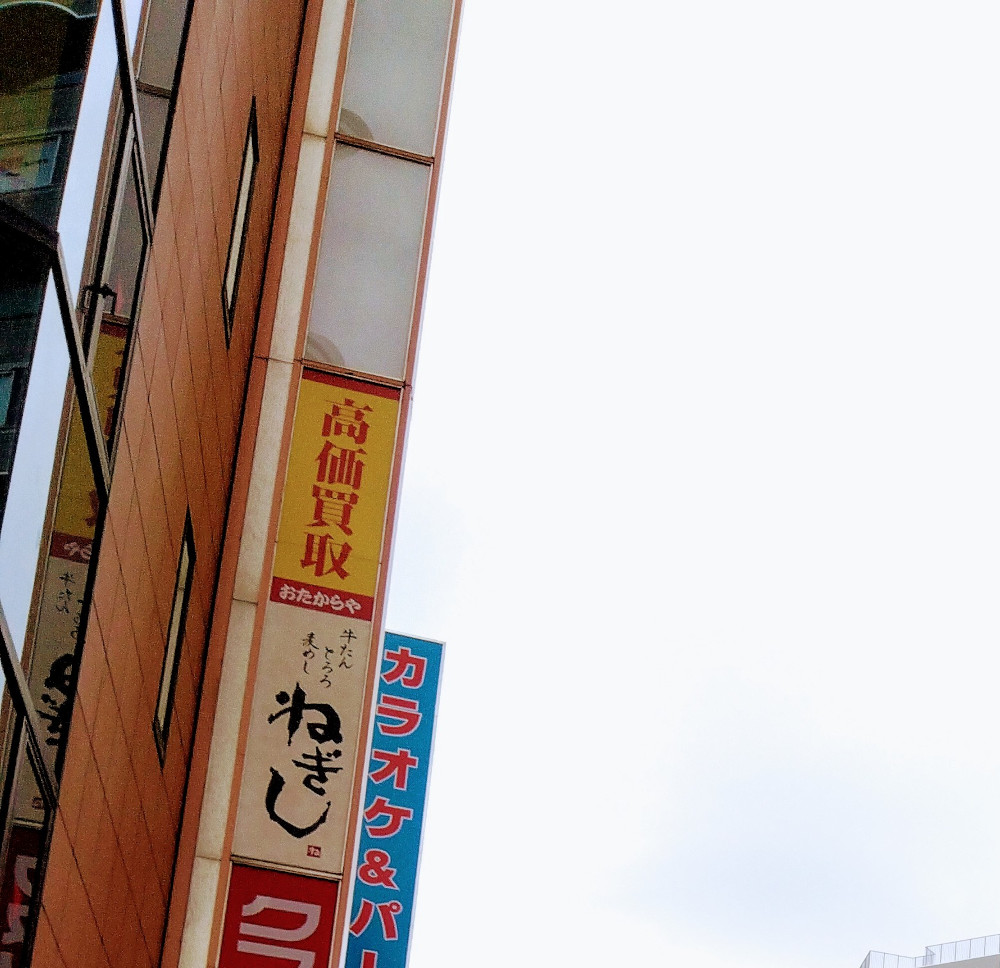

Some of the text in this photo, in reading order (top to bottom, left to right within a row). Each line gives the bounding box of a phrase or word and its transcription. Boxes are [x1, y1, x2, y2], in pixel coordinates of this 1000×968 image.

[300, 398, 374, 580] 高価買取
[278, 583, 362, 614] おたからや
[338, 628, 358, 670] 牛たん
[266, 681, 344, 839] ねぎし
